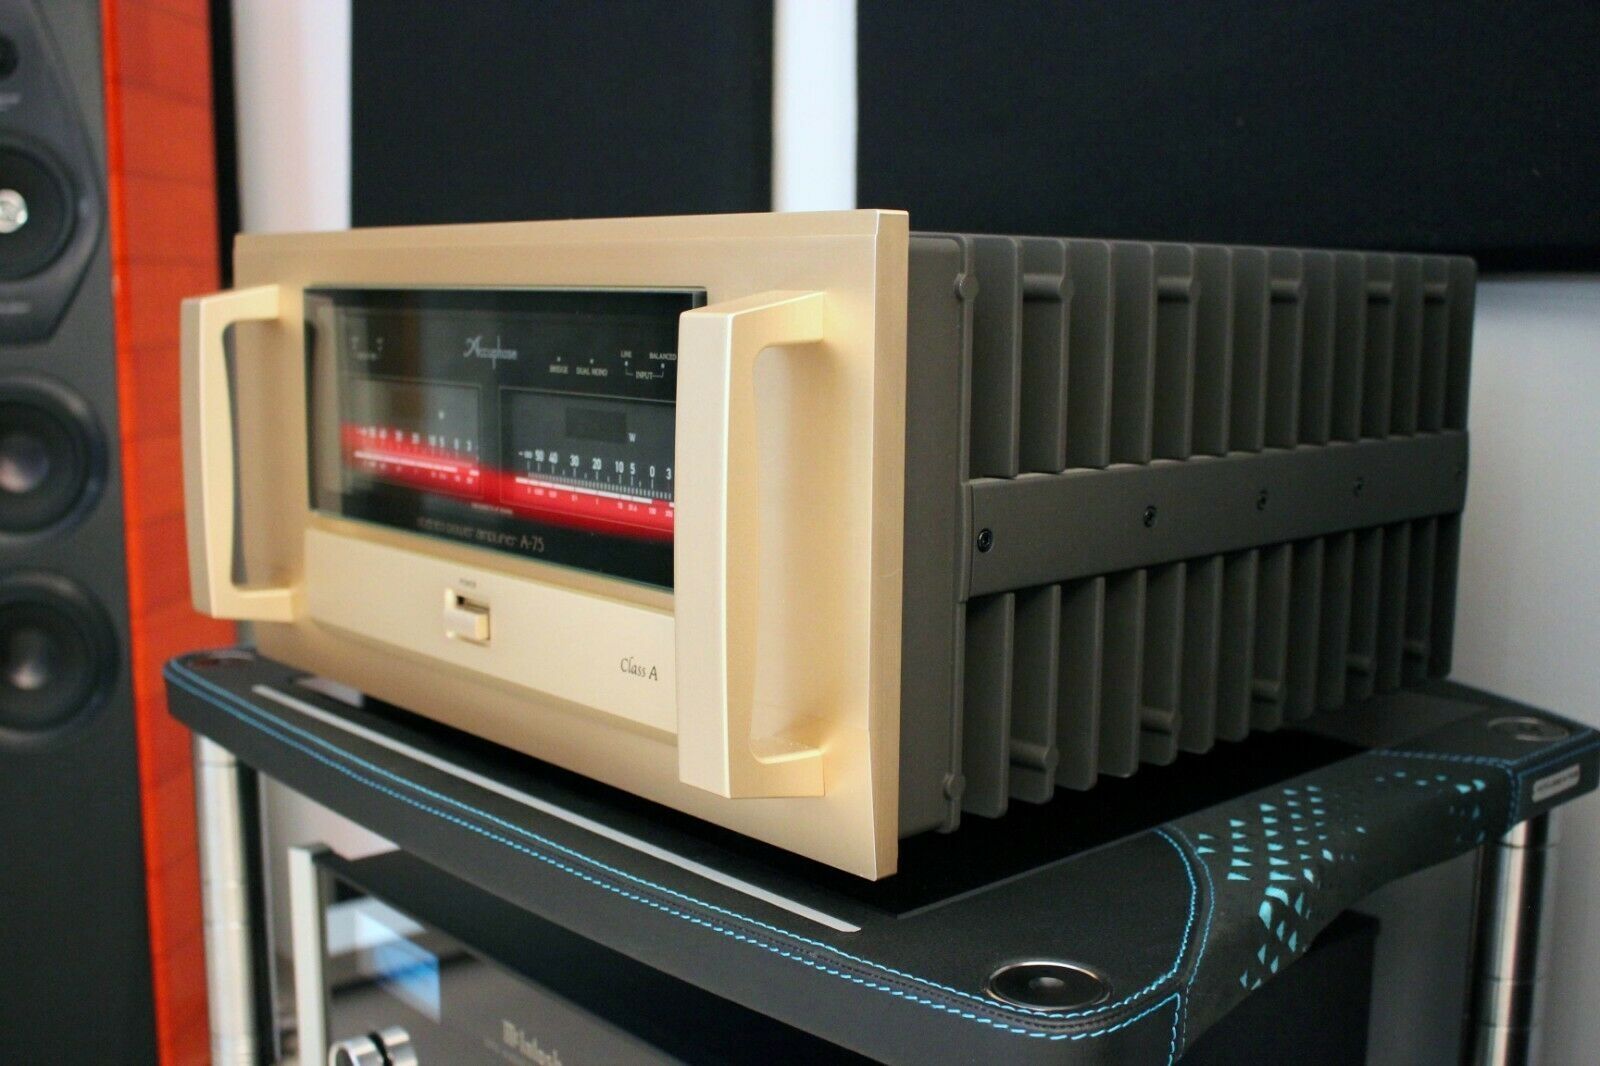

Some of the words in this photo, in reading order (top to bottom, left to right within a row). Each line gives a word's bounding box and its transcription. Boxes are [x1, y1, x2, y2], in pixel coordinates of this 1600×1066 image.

[649, 352, 677, 360] BALANCED
[635, 371, 653, 380] INPUT
[628, 433, 636, 442] W
[548, 452, 559, 464] 40
[569, 454, 580, 467] 30
[592, 457, 602, 470] 20
[615, 461, 624, 473] 10
[630, 462, 636, 475] 5
[649, 465, 656, 478] 0
[665, 467, 672, 480] 3
[519, 535, 545, 553] A-75
[620, 656, 646, 678] Class
[648, 664, 658, 681] A
